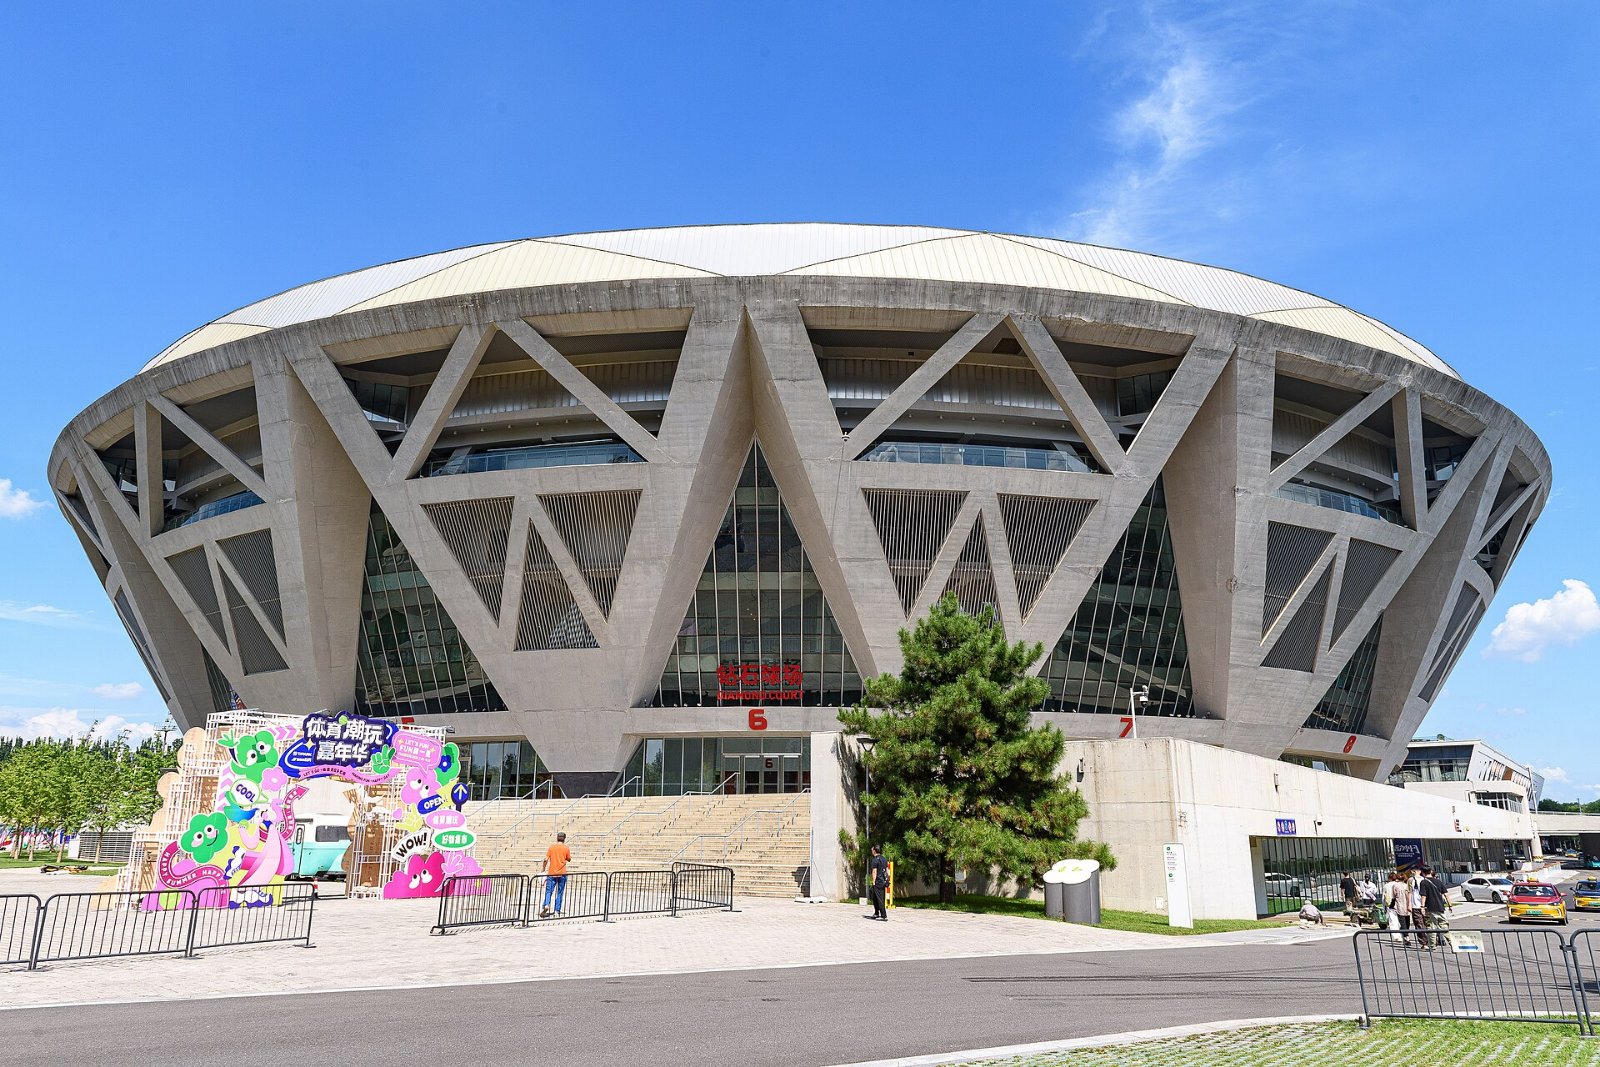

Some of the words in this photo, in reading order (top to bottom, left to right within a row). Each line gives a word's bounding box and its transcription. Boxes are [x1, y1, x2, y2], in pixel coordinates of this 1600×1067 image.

[717, 663, 803, 686] 钻石球场
[717, 690, 767, 700] DIAMOND
[769, 690, 804, 700] COURT
[749, 709, 767, 730] 6
[1119, 717, 1133, 738] 7
[306, 717, 384, 745] 体育潮玩
[317, 740, 370, 763] 嘉年华
[1343, 735, 1357, 753] 8
[765, 758, 773, 768] 6
[235, 783, 256, 803] COOL
[396, 832, 428, 858] WOW!
[162, 851, 171, 878] HAPPY
[167, 872, 197, 885] SUMMER
